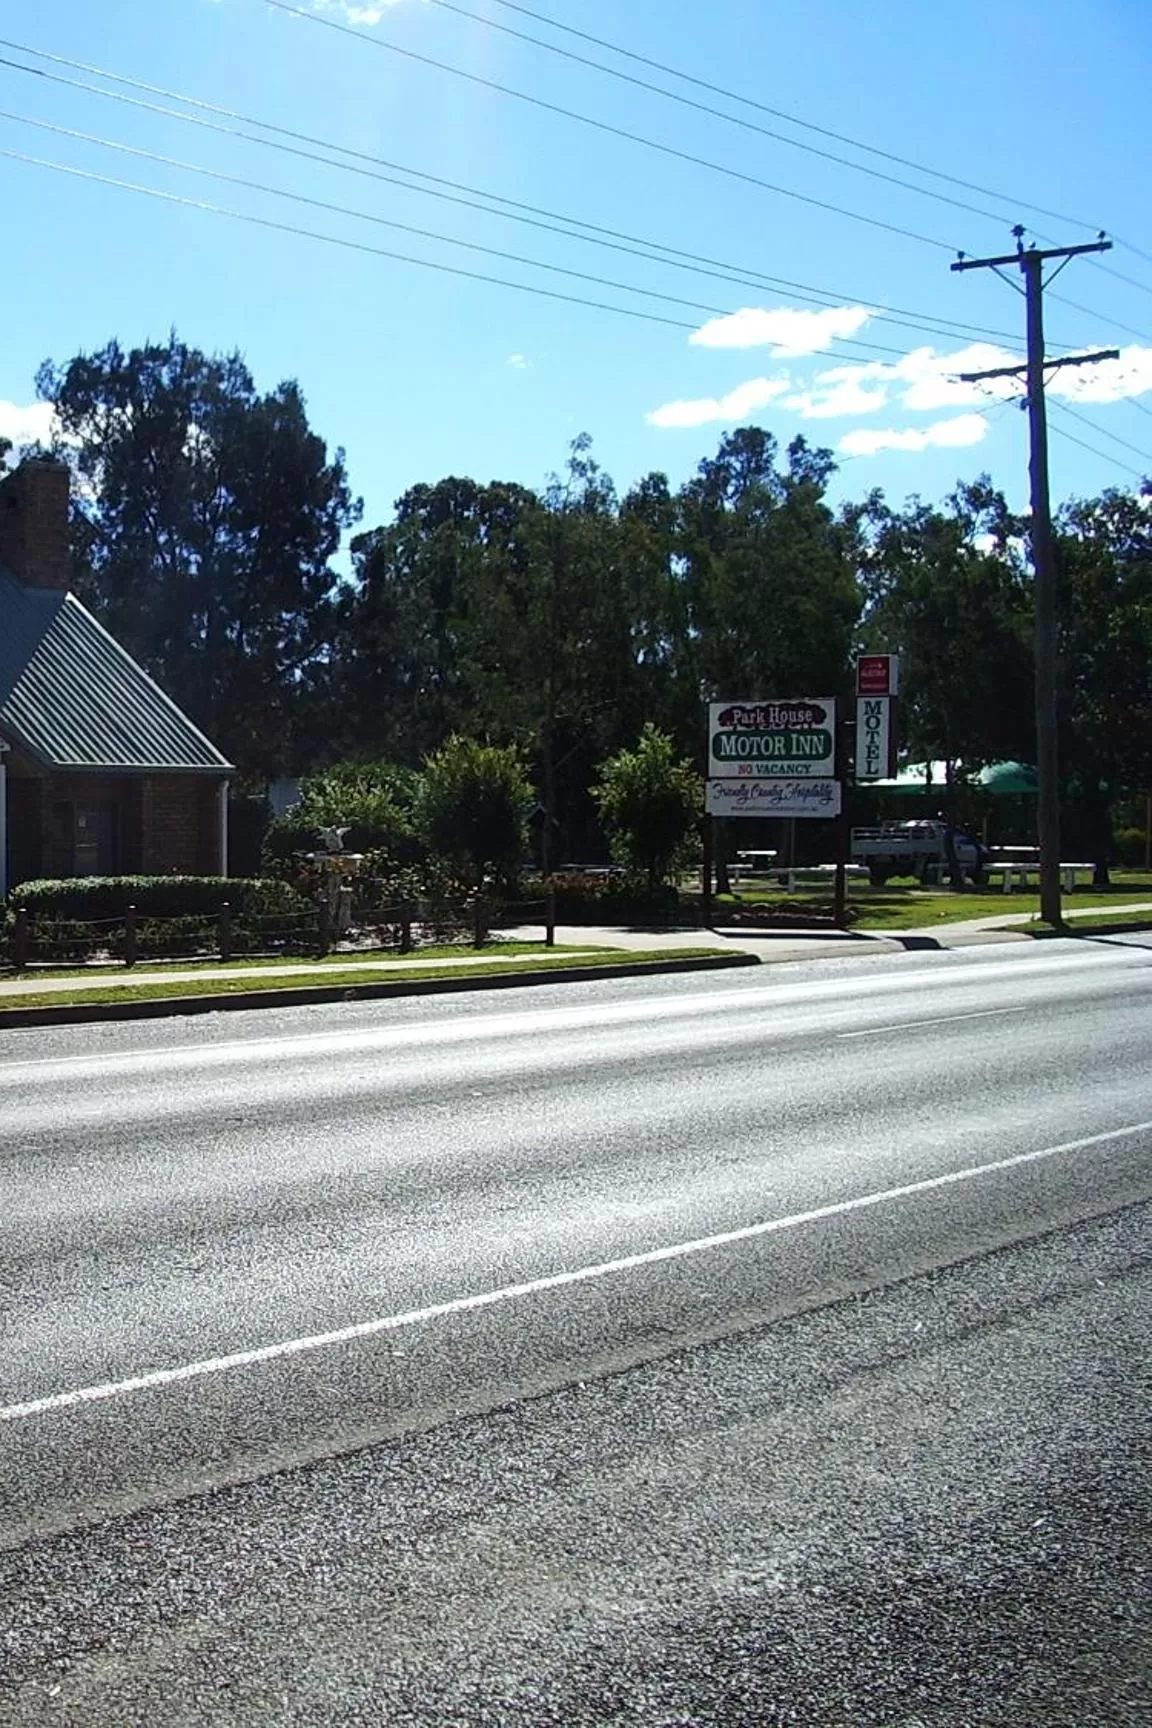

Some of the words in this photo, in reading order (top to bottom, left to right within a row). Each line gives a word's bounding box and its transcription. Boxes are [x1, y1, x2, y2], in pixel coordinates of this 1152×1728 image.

[732, 708, 765, 725] Park
[769, 706, 814, 724] House
[719, 735, 787, 757] MOTOR
[791, 734, 825, 756] INN
[864, 700, 882, 776] MOTEL
[738, 764, 753, 775] NO
[756, 763, 812, 775] VACANCY
[711, 782, 750, 805] Friendly
